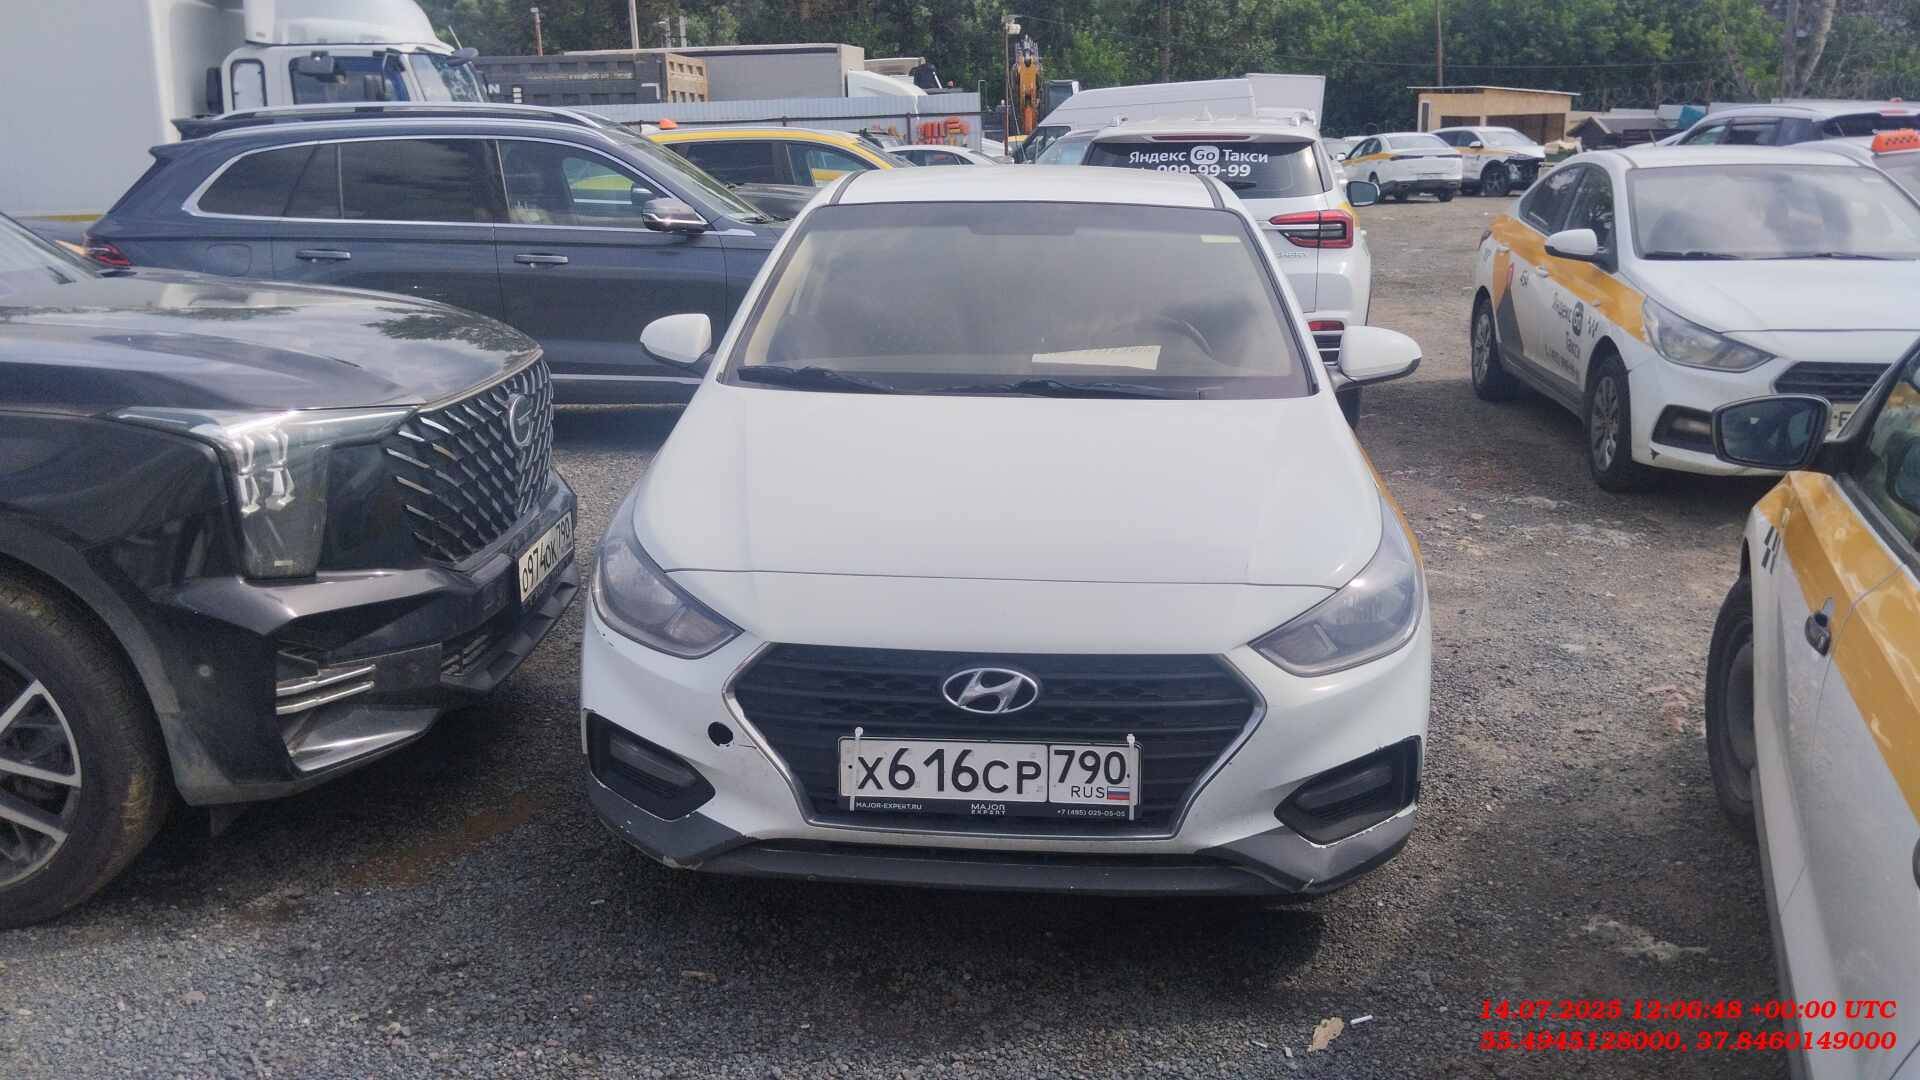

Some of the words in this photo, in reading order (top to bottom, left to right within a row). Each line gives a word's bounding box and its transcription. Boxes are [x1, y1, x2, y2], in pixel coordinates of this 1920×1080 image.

[1129, 150, 1187, 163] Яндекс
[1192, 148, 1218, 162] Go
[1222, 149, 1268, 163] Такси
[858, 747, 1042, 794] Х616СР
[1054, 750, 1126, 785] 790
[1071, 786, 1105, 799] RUS
[971, 803, 1005, 811] MAJOR
